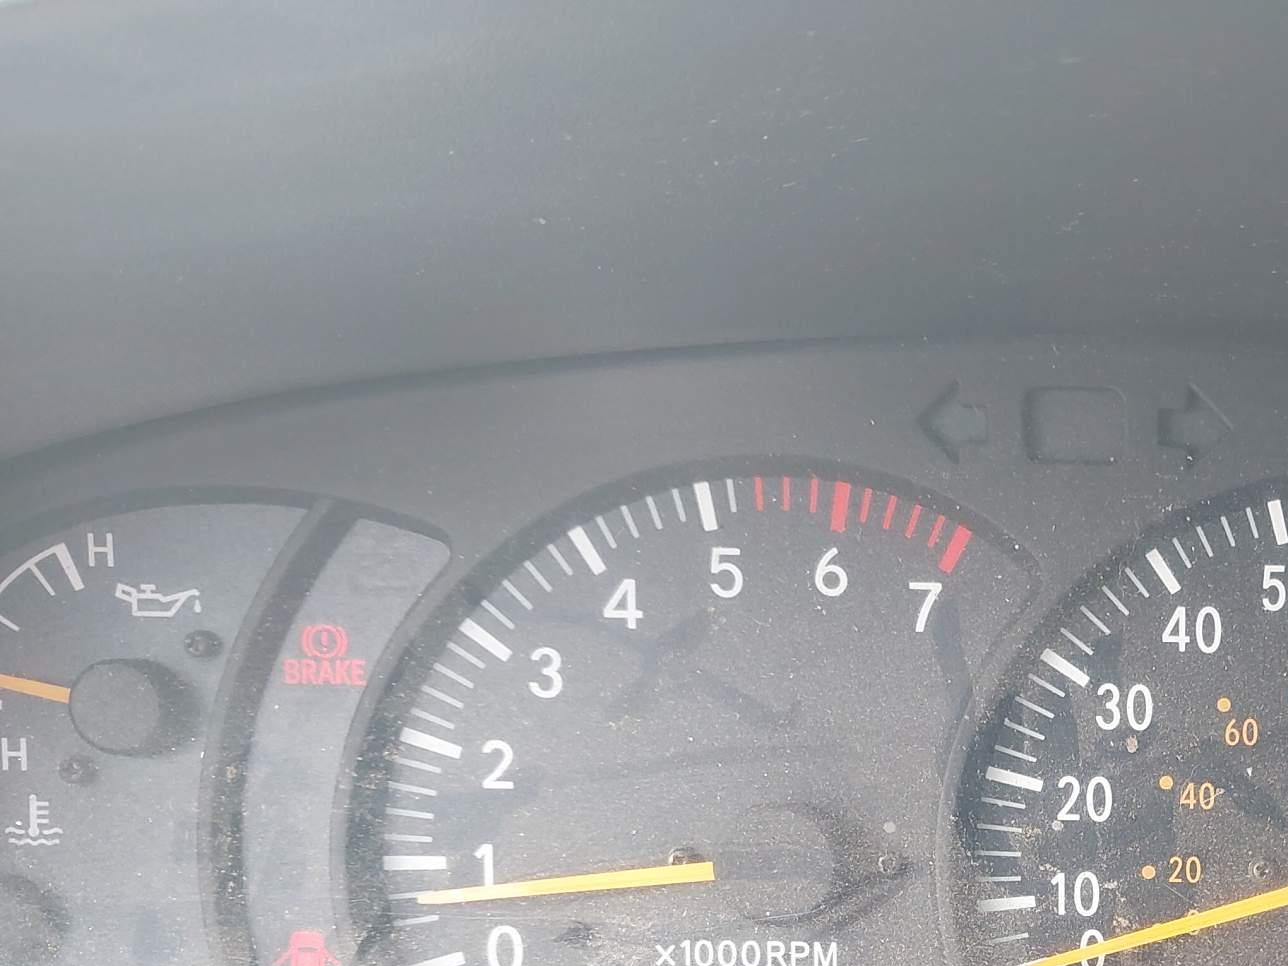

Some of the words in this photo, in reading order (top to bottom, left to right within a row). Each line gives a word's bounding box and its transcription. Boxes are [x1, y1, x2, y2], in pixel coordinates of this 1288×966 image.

[88, 533, 114, 567] H
[711, 547, 743, 598] 5
[815, 548, 847, 596] 6
[603, 579, 643, 629] 4
[909, 582, 942, 632] 7
[1162, 606, 1222, 653] 40
[282, 659, 367, 687] BRAKE
[529, 647, 563, 698] 3
[1096, 683, 1153, 730] 30
[2, 738, 27, 771] H
[1223, 717, 1260, 747] 60
[482, 740, 513, 789] 2
[1057, 776, 1112, 822] 20
[1179, 781, 1216, 811] 40
[474, 844, 495, 886] 1
[1168, 855, 1203, 885] 20
[1051, 870, 1099, 916] 10
